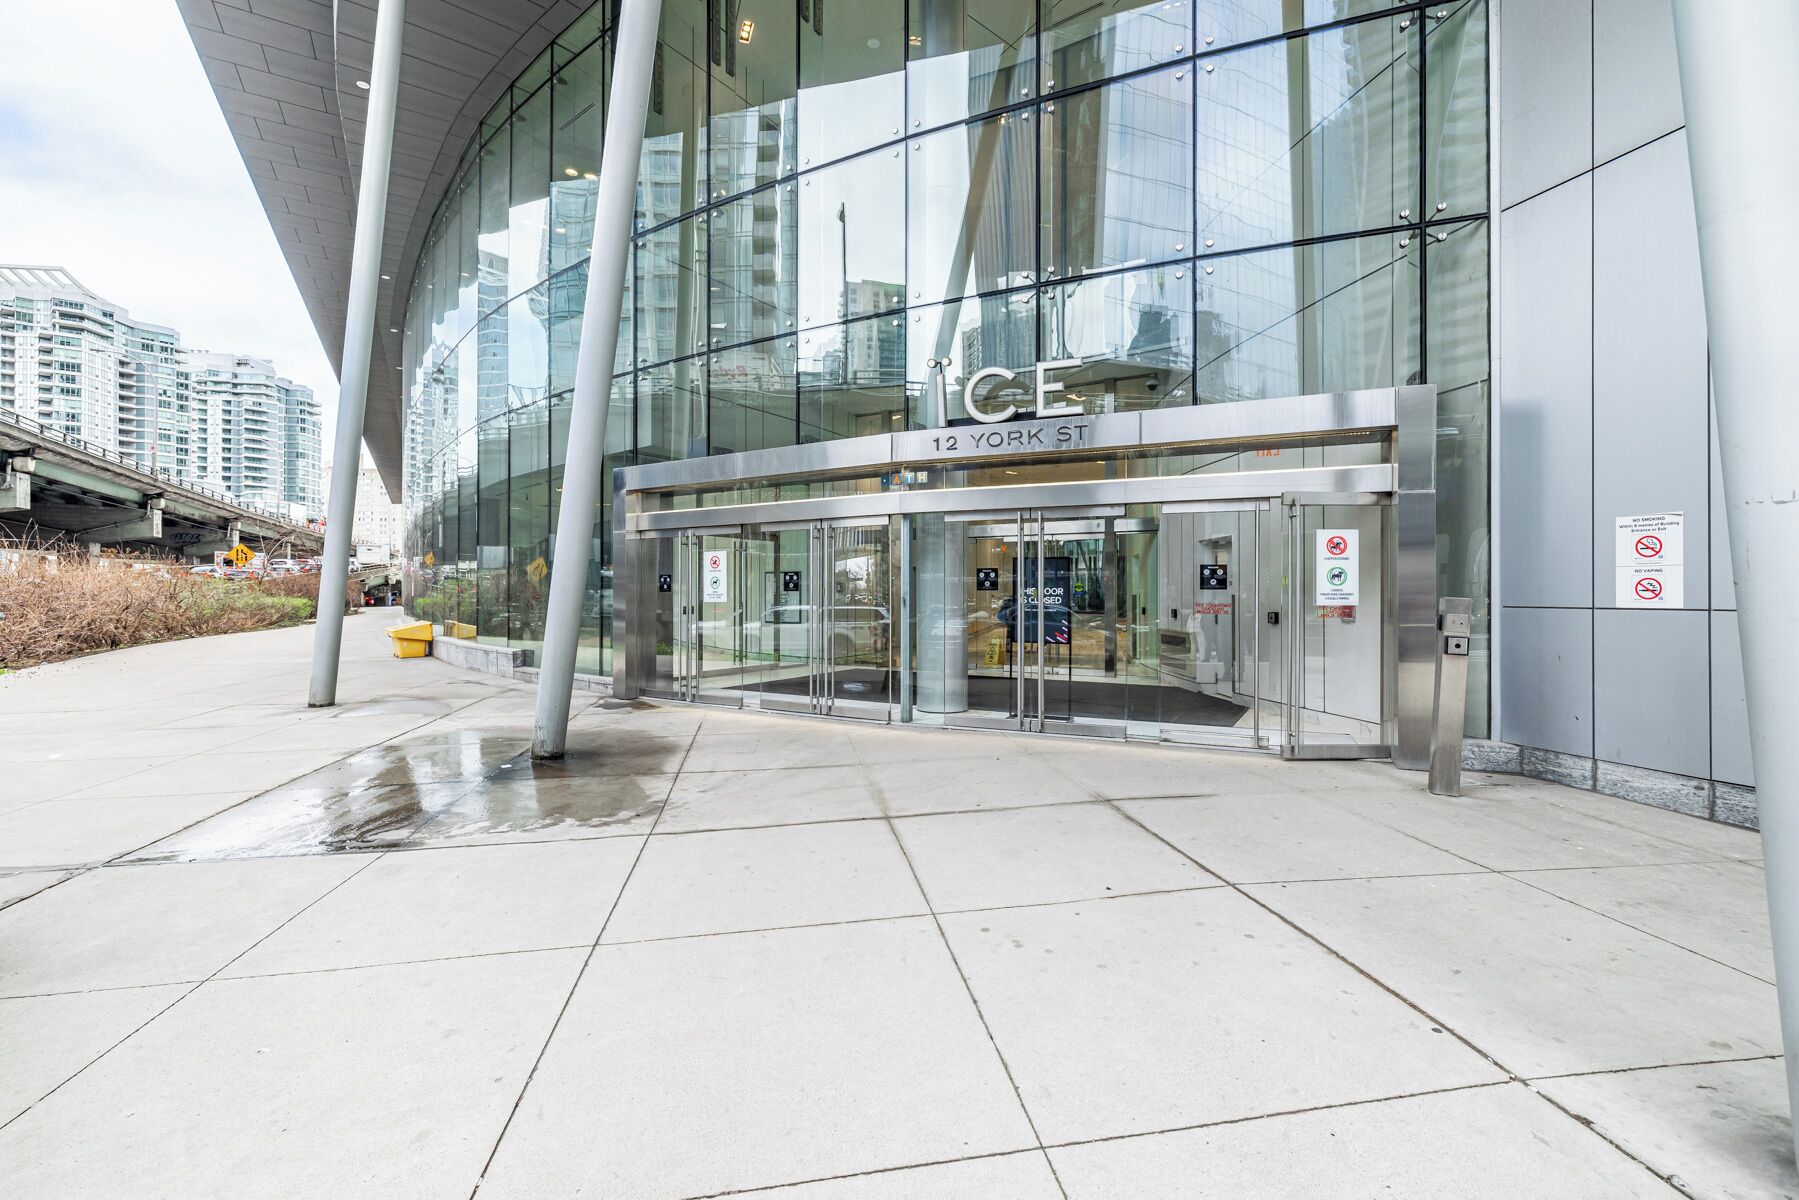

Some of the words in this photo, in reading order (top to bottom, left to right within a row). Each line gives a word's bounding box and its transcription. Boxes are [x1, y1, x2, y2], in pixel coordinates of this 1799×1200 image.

[933, 435, 958, 452] 12
[970, 427, 1045, 449] YORK
[1056, 424, 1089, 443] ST
